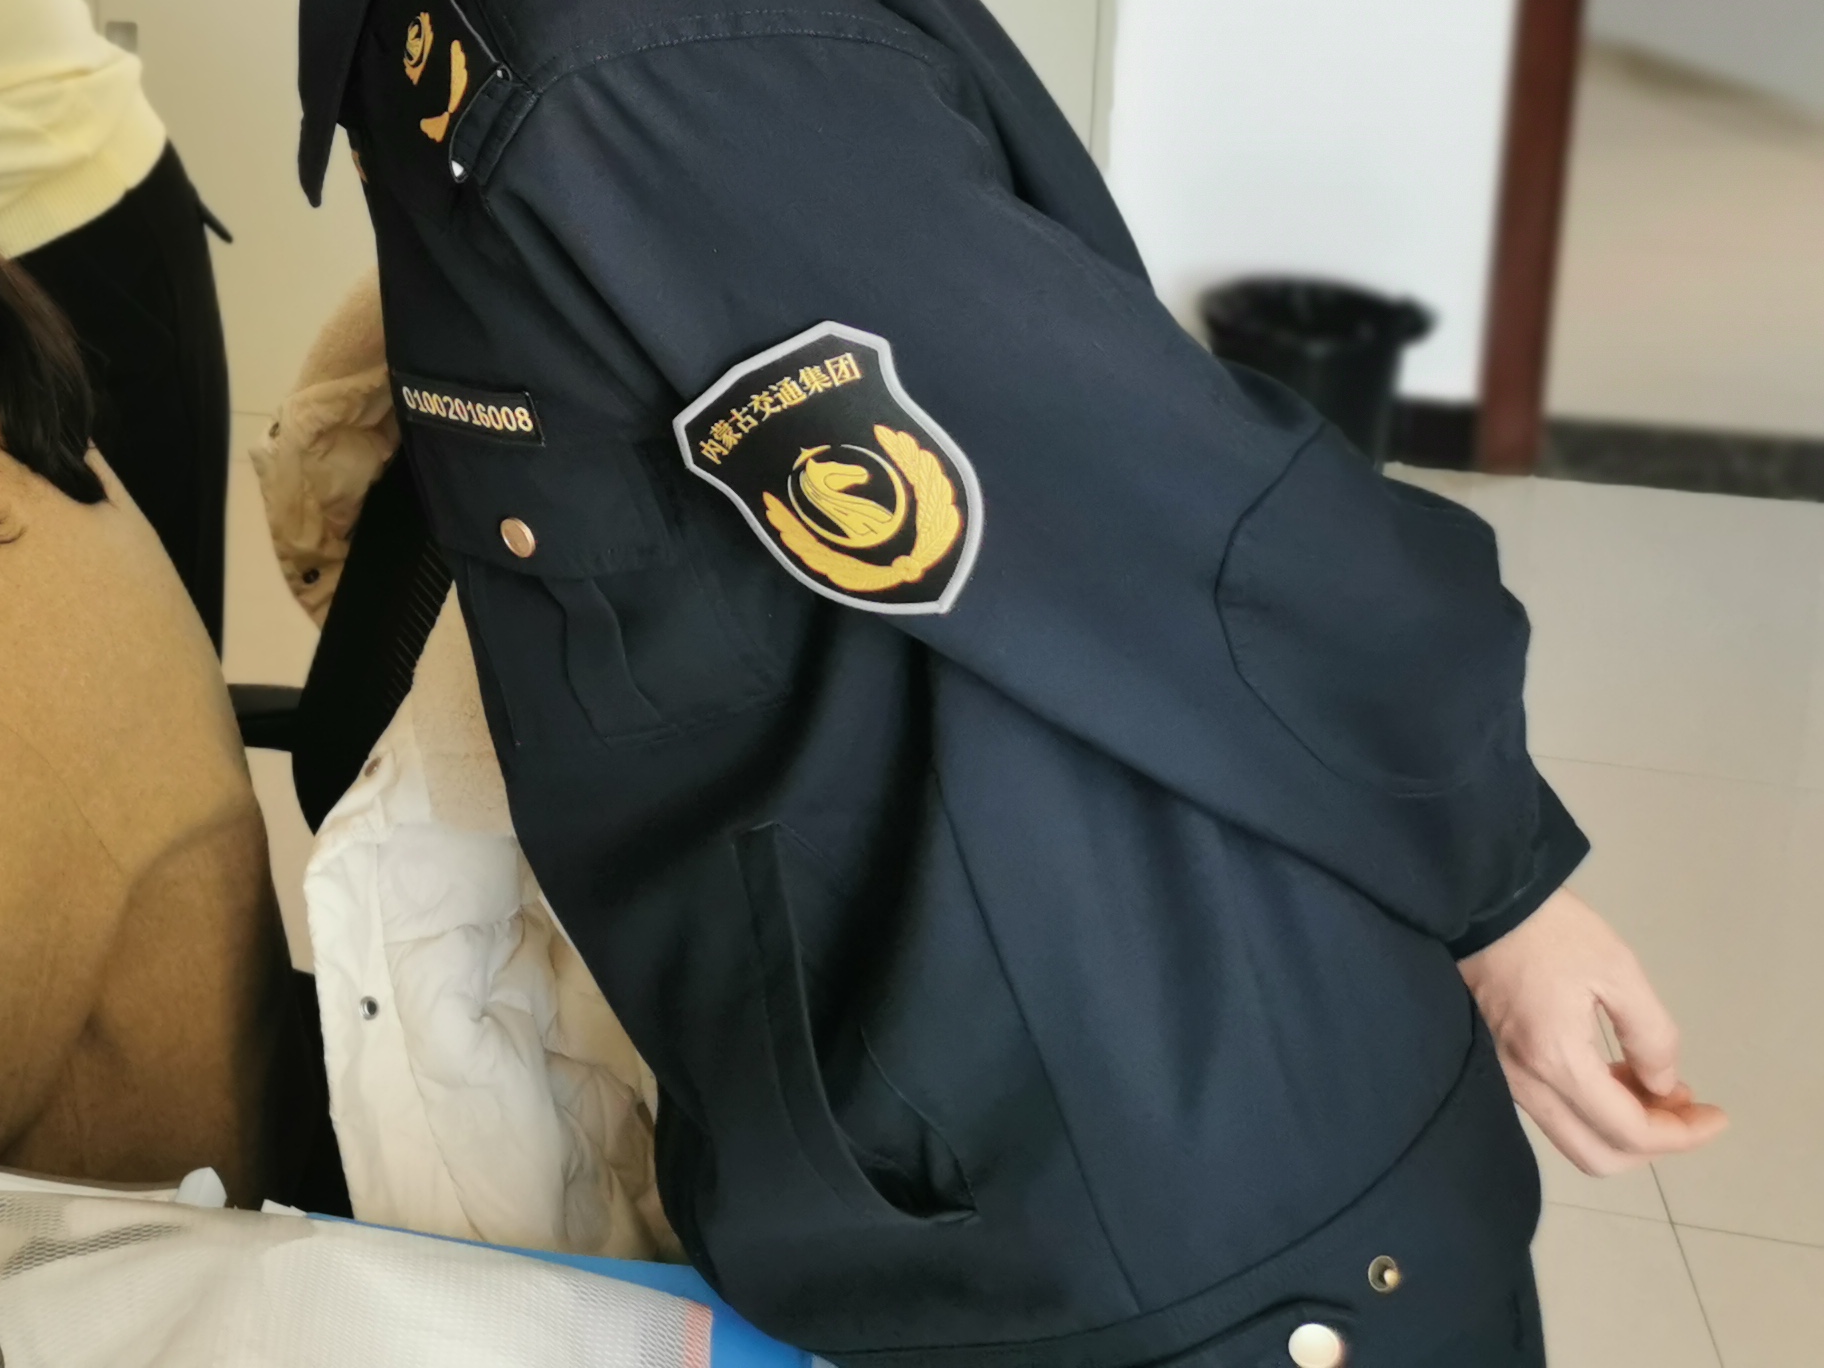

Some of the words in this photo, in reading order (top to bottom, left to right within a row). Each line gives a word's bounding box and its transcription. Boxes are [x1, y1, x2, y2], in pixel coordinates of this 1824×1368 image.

[402, 386, 533, 432] 01002016008
[699, 352, 862, 465] 内蒙古交通集团
